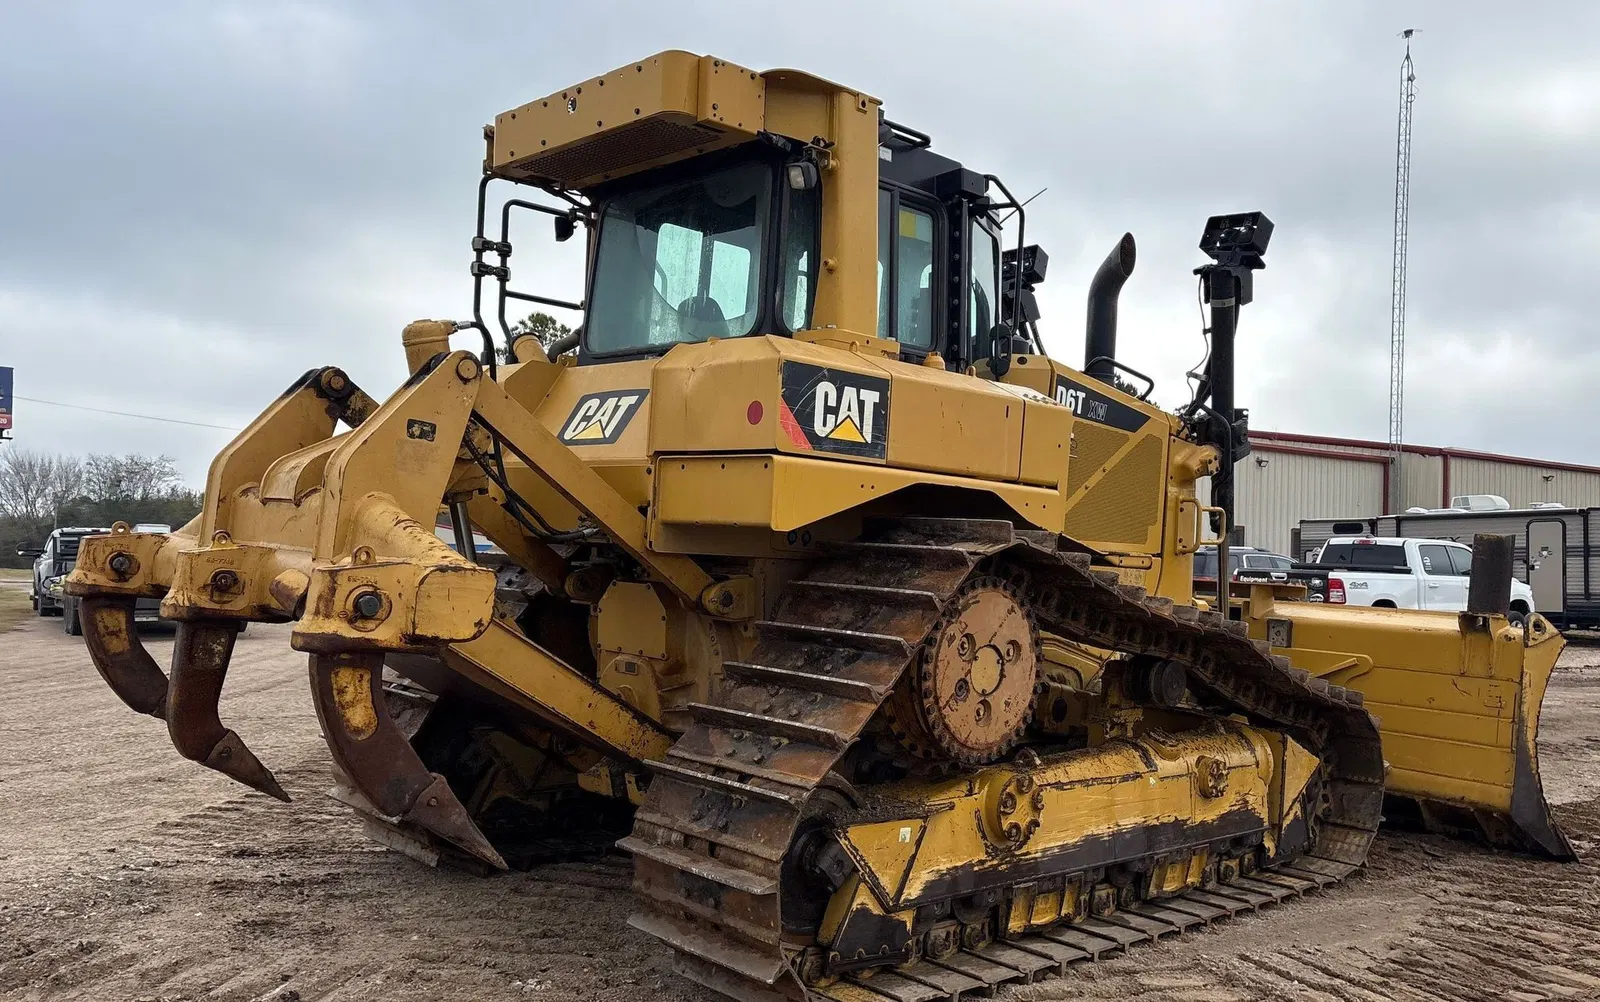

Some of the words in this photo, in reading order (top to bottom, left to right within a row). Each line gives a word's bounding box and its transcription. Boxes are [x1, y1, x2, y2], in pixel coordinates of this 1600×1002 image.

[563, 395, 640, 440] CAT
[814, 381, 880, 443] CAT
[1056, 385, 1086, 414] D6T
[1088, 400, 1108, 421] XW
[1240, 575, 1268, 583] Equipment
